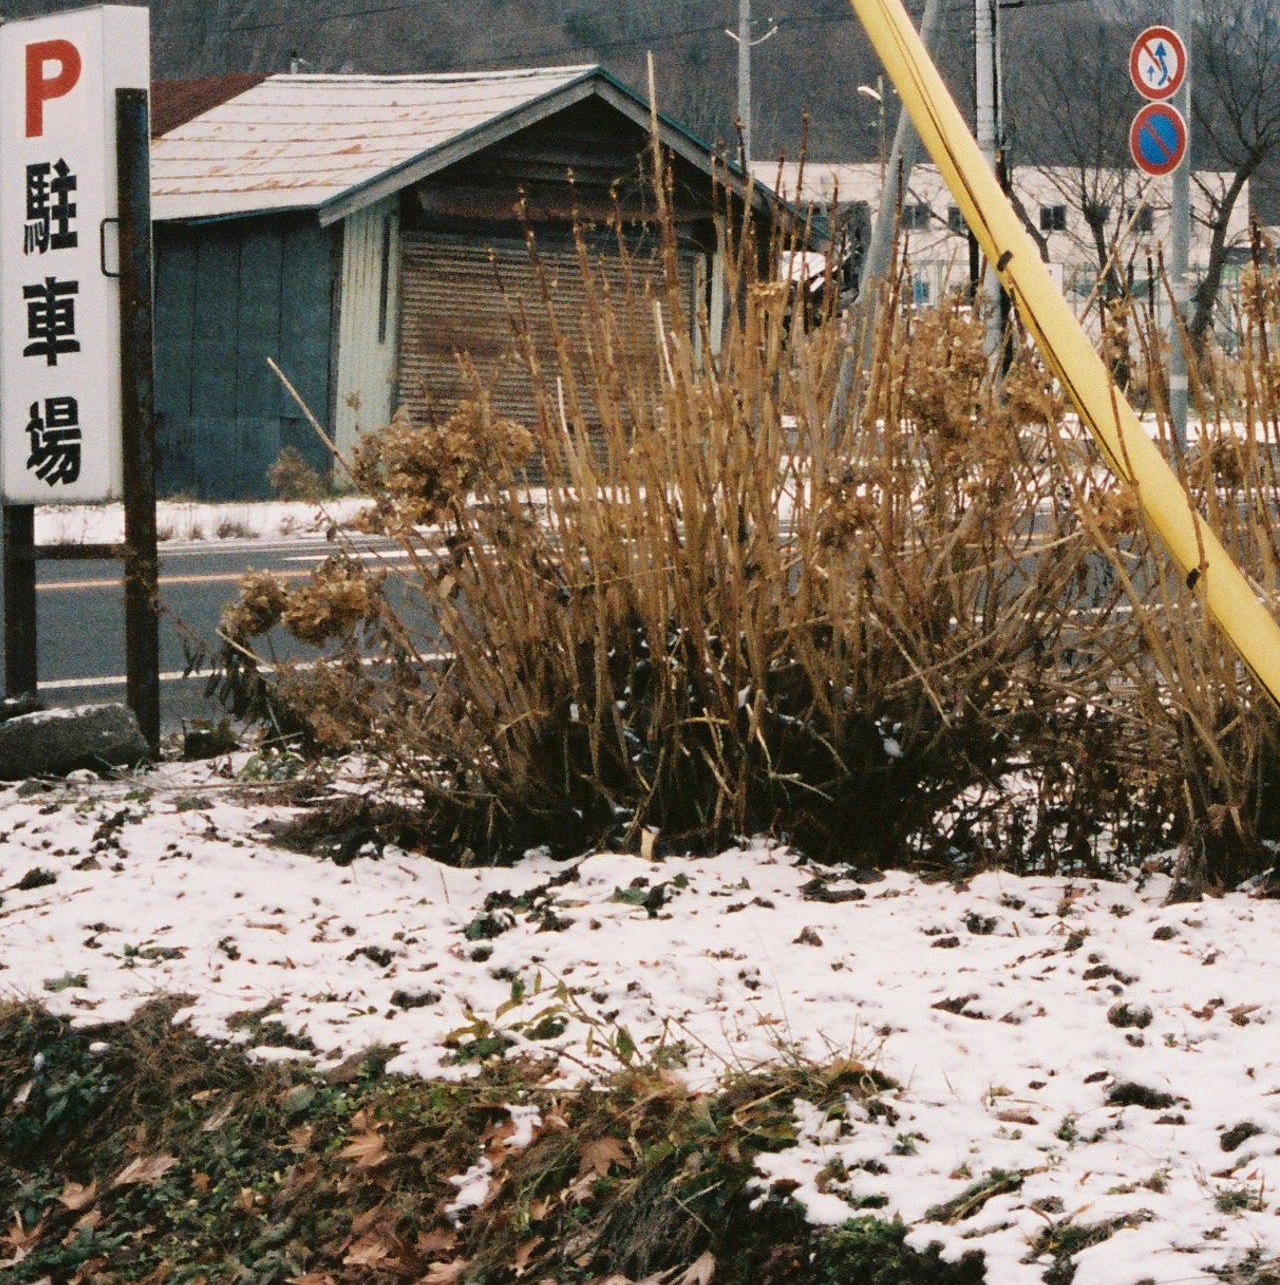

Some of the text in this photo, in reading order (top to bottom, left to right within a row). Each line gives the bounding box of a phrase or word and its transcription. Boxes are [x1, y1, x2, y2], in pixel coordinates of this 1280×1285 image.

[24, 38, 82, 139] P
[22, 157, 83, 487] 駐車場
